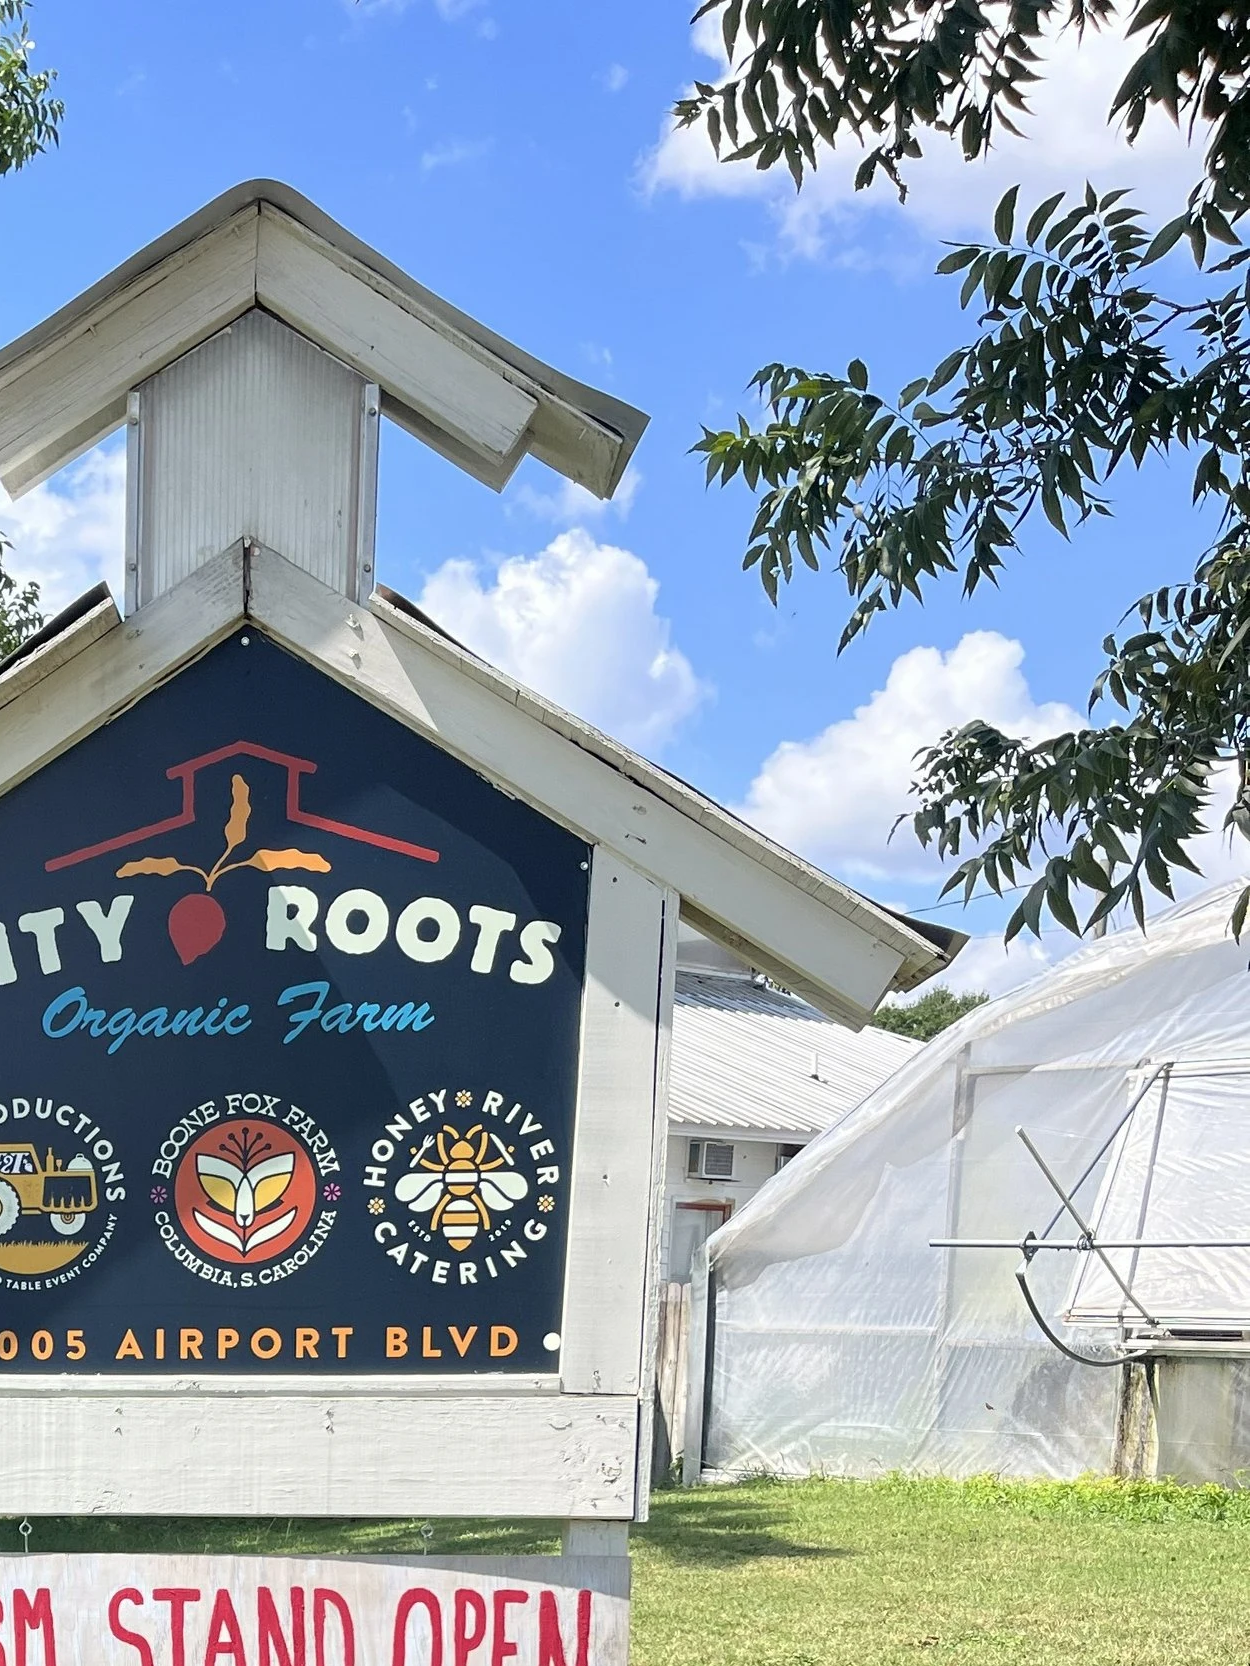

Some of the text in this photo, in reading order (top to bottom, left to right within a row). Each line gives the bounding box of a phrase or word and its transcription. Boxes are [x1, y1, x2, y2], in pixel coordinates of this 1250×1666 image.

[265, 885, 562, 985] ROOTS
[42, 980, 435, 1055] Organic Farm
[151, 1093, 341, 1179] BOONE FOX FARM
[362, 1088, 560, 1187] HONEY RIVER
[6, 1278, 42, 1291] TABLE
[45, 1265, 81, 1289] EVENT
[82, 1213, 118, 1268] COMPANY
[154, 1211, 239, 1289] COLUMBIA,
[258, 1210, 338, 1285] CAROLINA
[374, 1218, 548, 1285] CATERING
[407, 1218, 512, 1243] ESTD 2019
[115, 1326, 354, 1360] AIRPORT
[385, 1325, 519, 1358] BLVD
